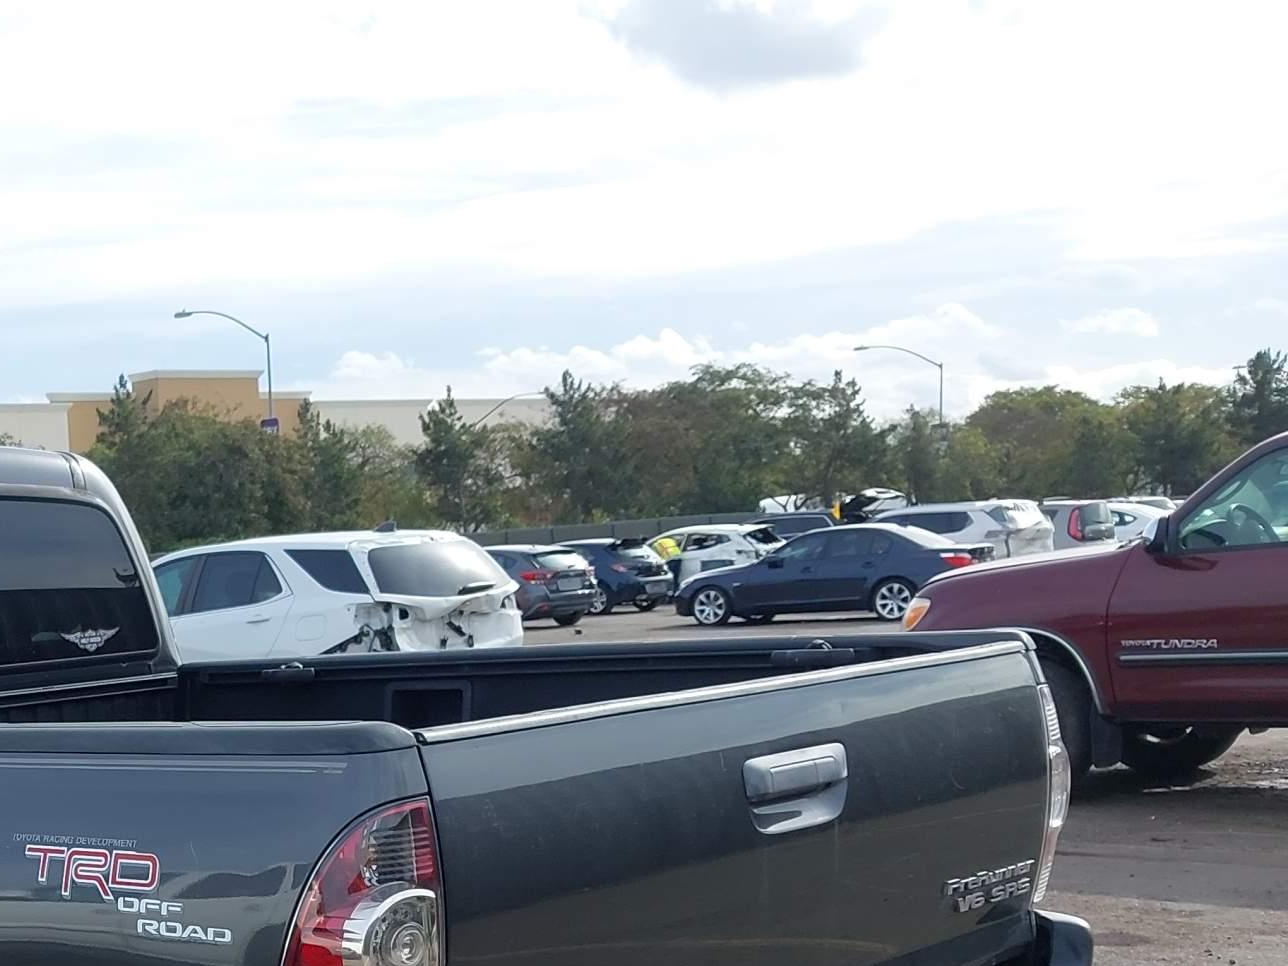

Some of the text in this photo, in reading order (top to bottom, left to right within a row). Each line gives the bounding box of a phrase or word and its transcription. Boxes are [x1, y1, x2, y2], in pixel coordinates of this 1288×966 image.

[1149, 638, 1218, 649] TUNDRA
[12, 833, 138, 848] TOYOTA RACING DEVELOPMENT
[24, 844, 160, 903] TRD
[116, 896, 184, 917] OFF
[955, 877, 1031, 913] V6 SR5
[136, 918, 234, 944] ROAD
